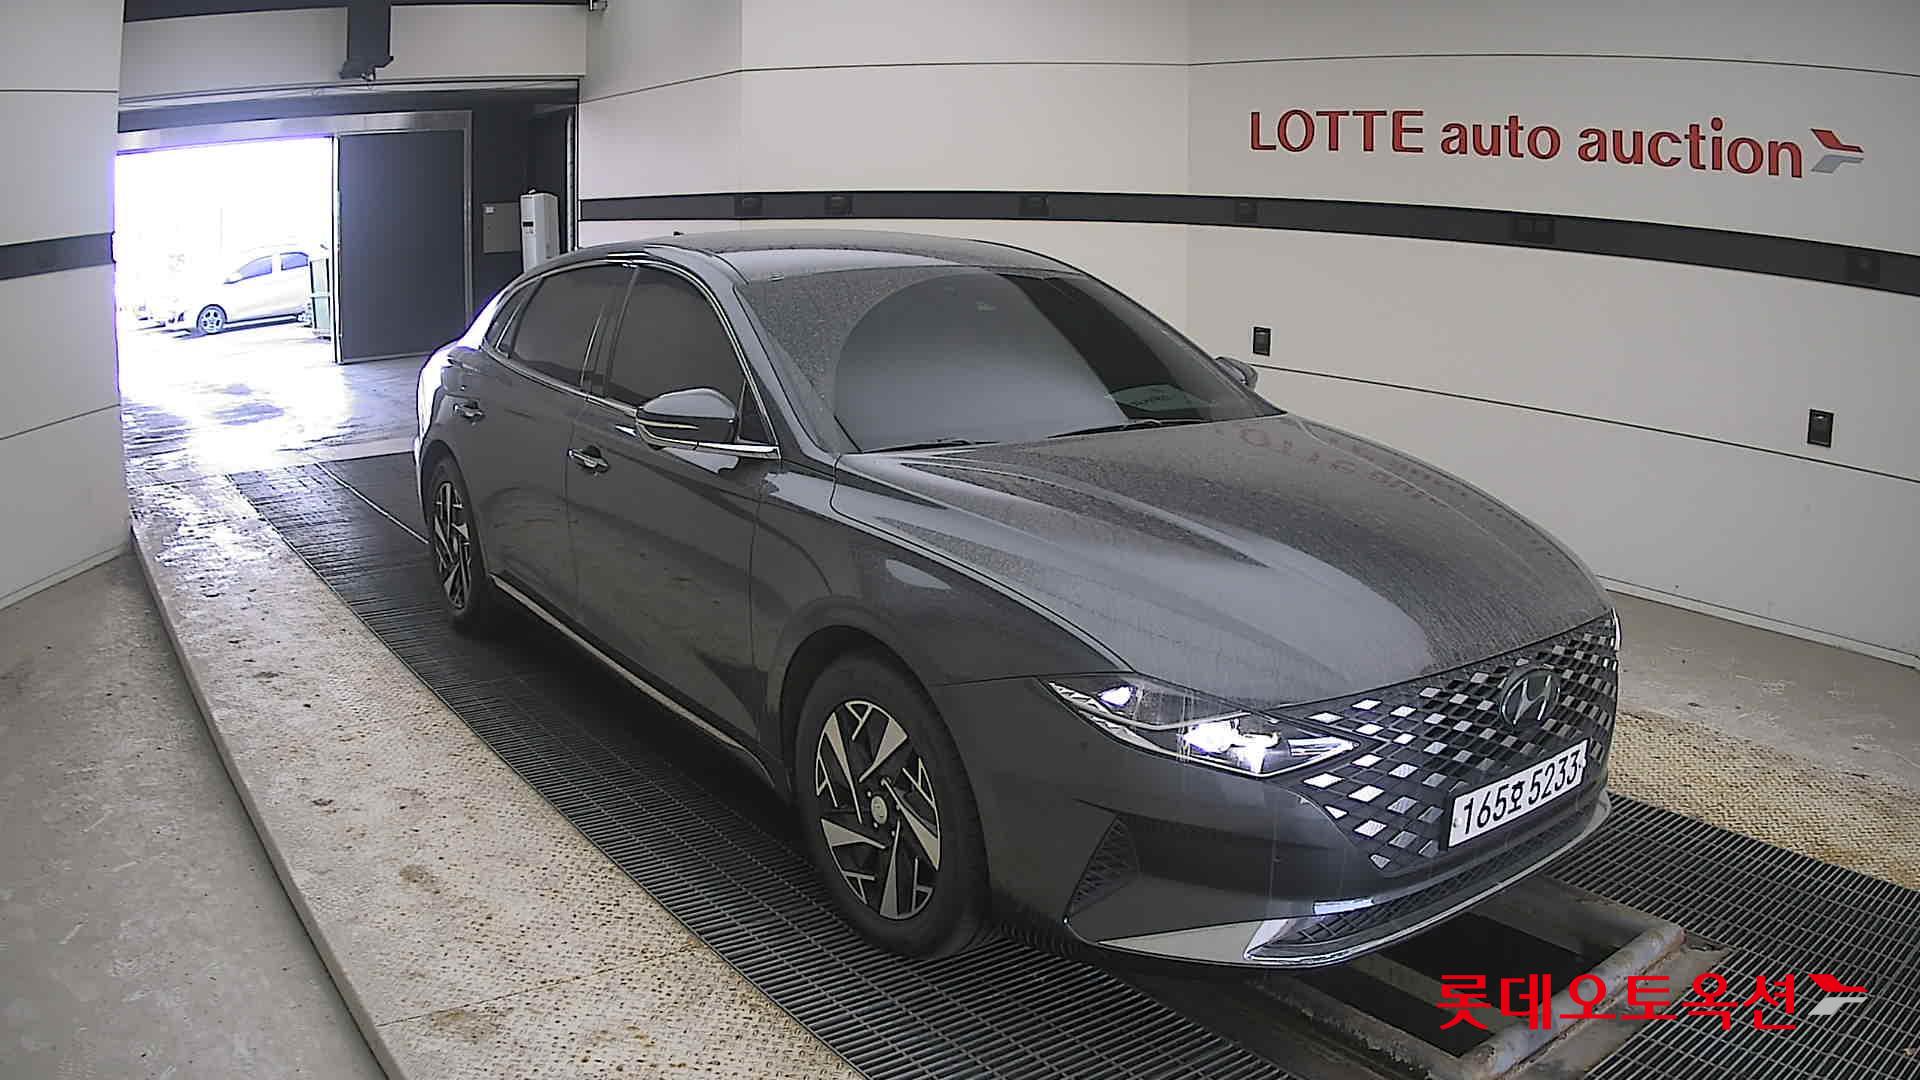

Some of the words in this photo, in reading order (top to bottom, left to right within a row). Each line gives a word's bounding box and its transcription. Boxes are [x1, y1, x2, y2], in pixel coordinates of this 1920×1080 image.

[1250, 110, 1425, 153] LOTTE
[1440, 116, 1561, 159] auto
[1577, 117, 1804, 179] auction
[1527, 750, 1580, 806] 5233
